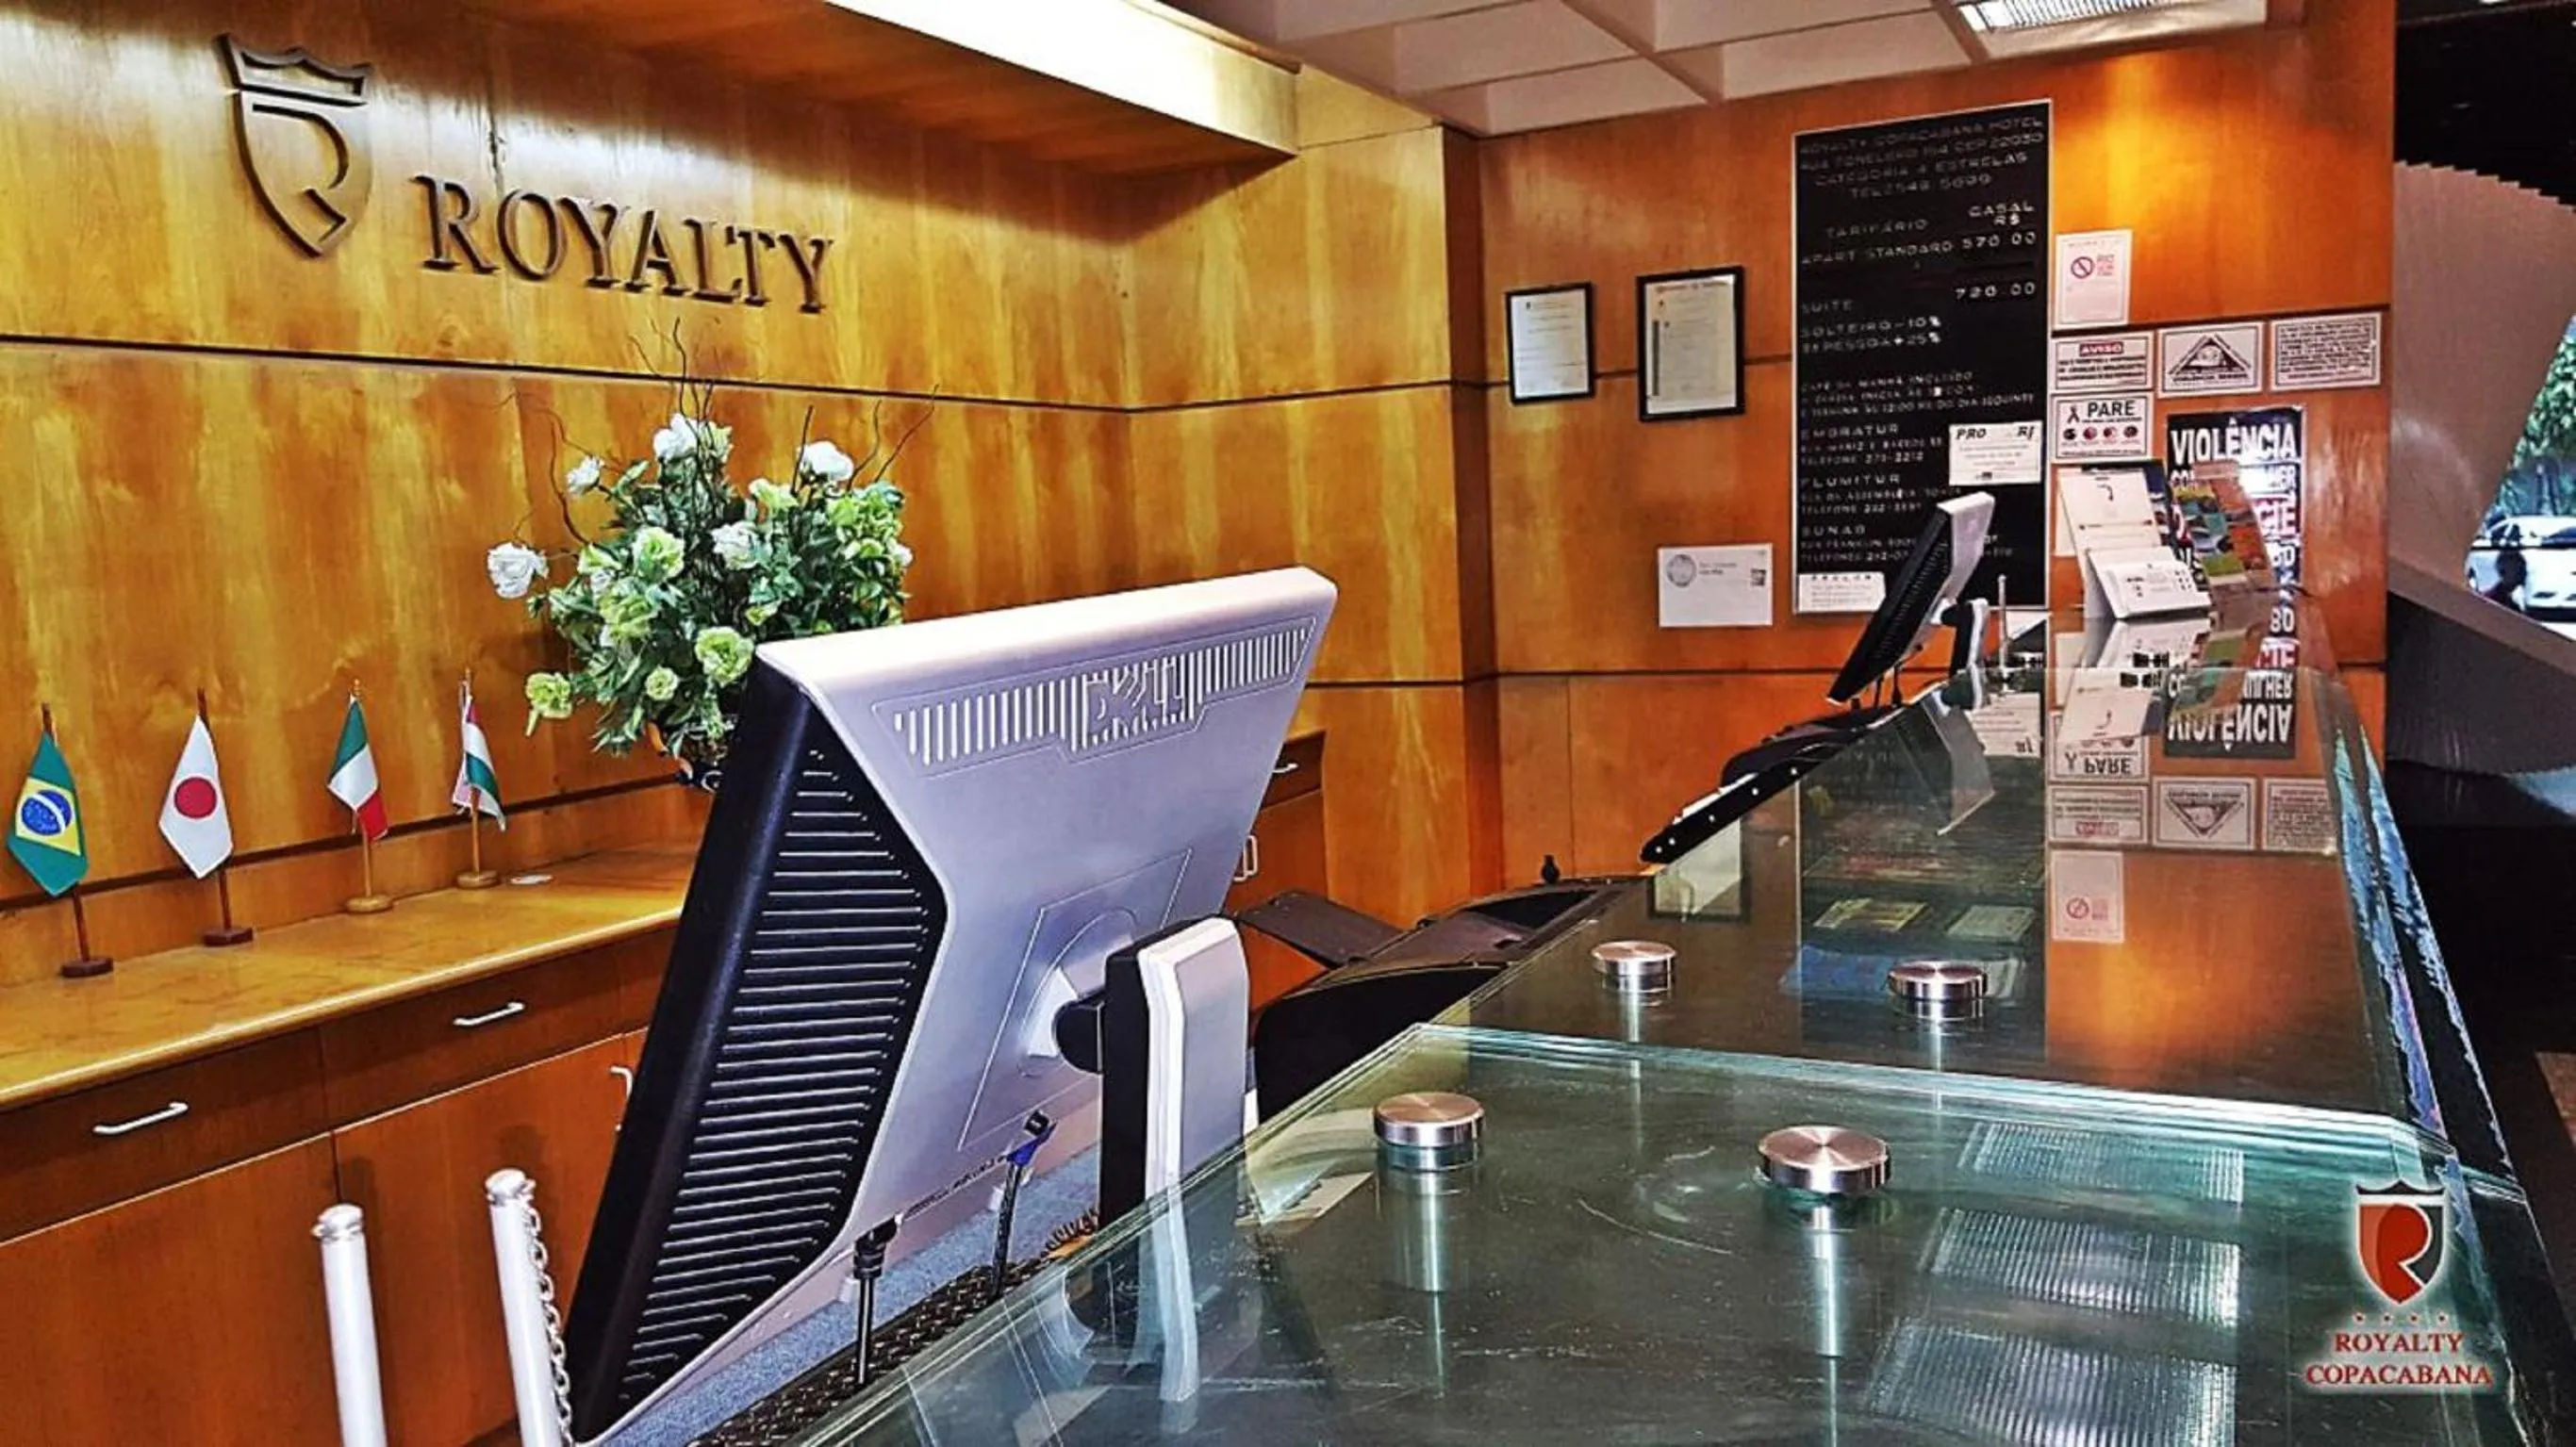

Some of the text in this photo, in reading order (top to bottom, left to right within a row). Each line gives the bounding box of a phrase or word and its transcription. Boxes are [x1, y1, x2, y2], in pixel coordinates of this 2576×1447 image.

[1989, 116, 2043, 131] HOTEL
[1936, 151, 2028, 173] ESTRELAS
[1969, 201, 2034, 218] CASAL
[410, 173, 834, 313] ROYALTY
[2081, 342, 2122, 354] AVISO
[2087, 400, 2136, 418] PARE
[1956, 427, 1987, 440] PRO
[2170, 417, 2298, 466] VIOLÊNCIA
